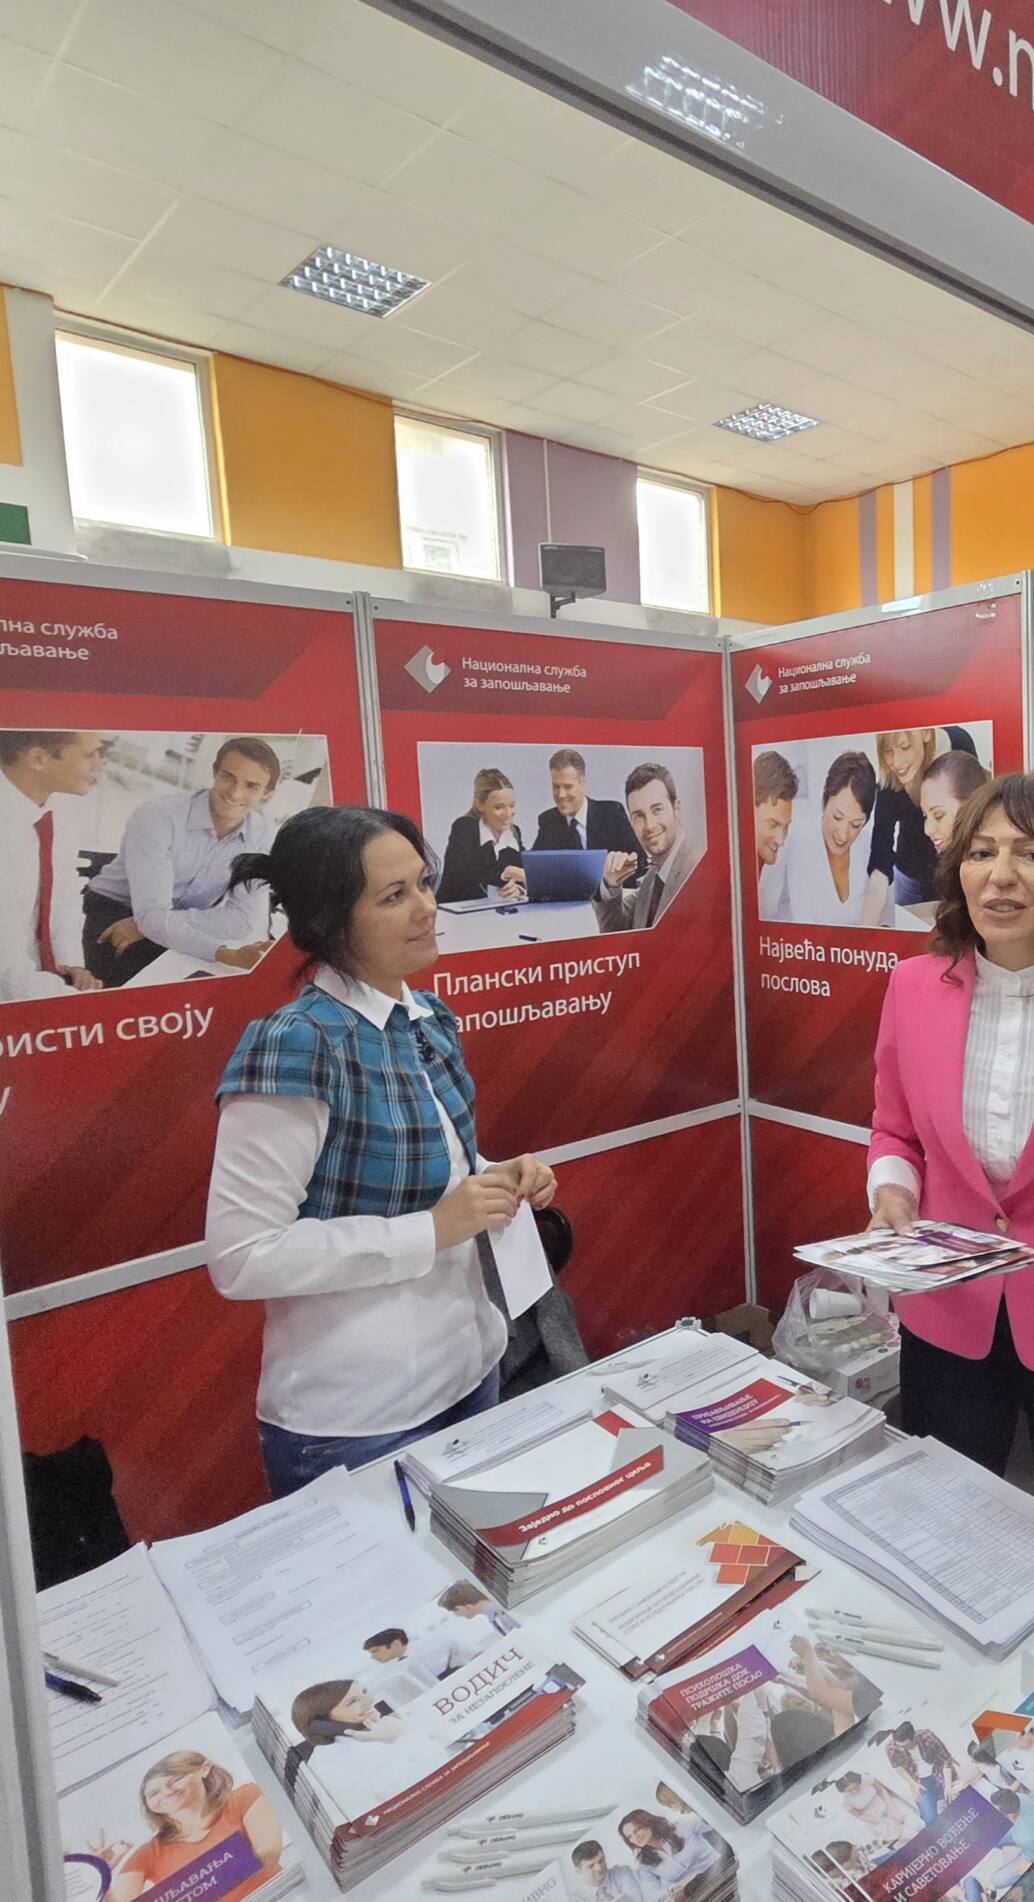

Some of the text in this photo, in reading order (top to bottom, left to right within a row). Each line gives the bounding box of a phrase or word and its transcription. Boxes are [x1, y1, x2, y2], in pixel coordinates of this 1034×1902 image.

[40, 622, 119, 640] служба
[462, 656, 588, 679] Национална служба
[777, 651, 872, 679] Национална служба
[778, 673, 857, 695] за запошљавање
[463, 676, 572, 694] за запошљавање
[759, 935, 900, 973] Највећа понуда
[433, 952, 641, 997] Плански приступ
[760, 973, 832, 998] послова
[0, 1003, 214, 1058] исти своју
[518, 1510, 561, 1533] Заједно
[561, 1504, 575, 1514] до
[575, 1477, 625, 1506] пословног
[432, 1648, 524, 1717] ВОДИЧ
[690, 1670, 764, 1711] ТРАЖИТЕ ПОСАО
[882, 1807, 980, 1894] КАРИЈЕРНО ВОЂЕЊЕ
[904, 1838, 971, 1898] САВЕТОВАЊЕ
